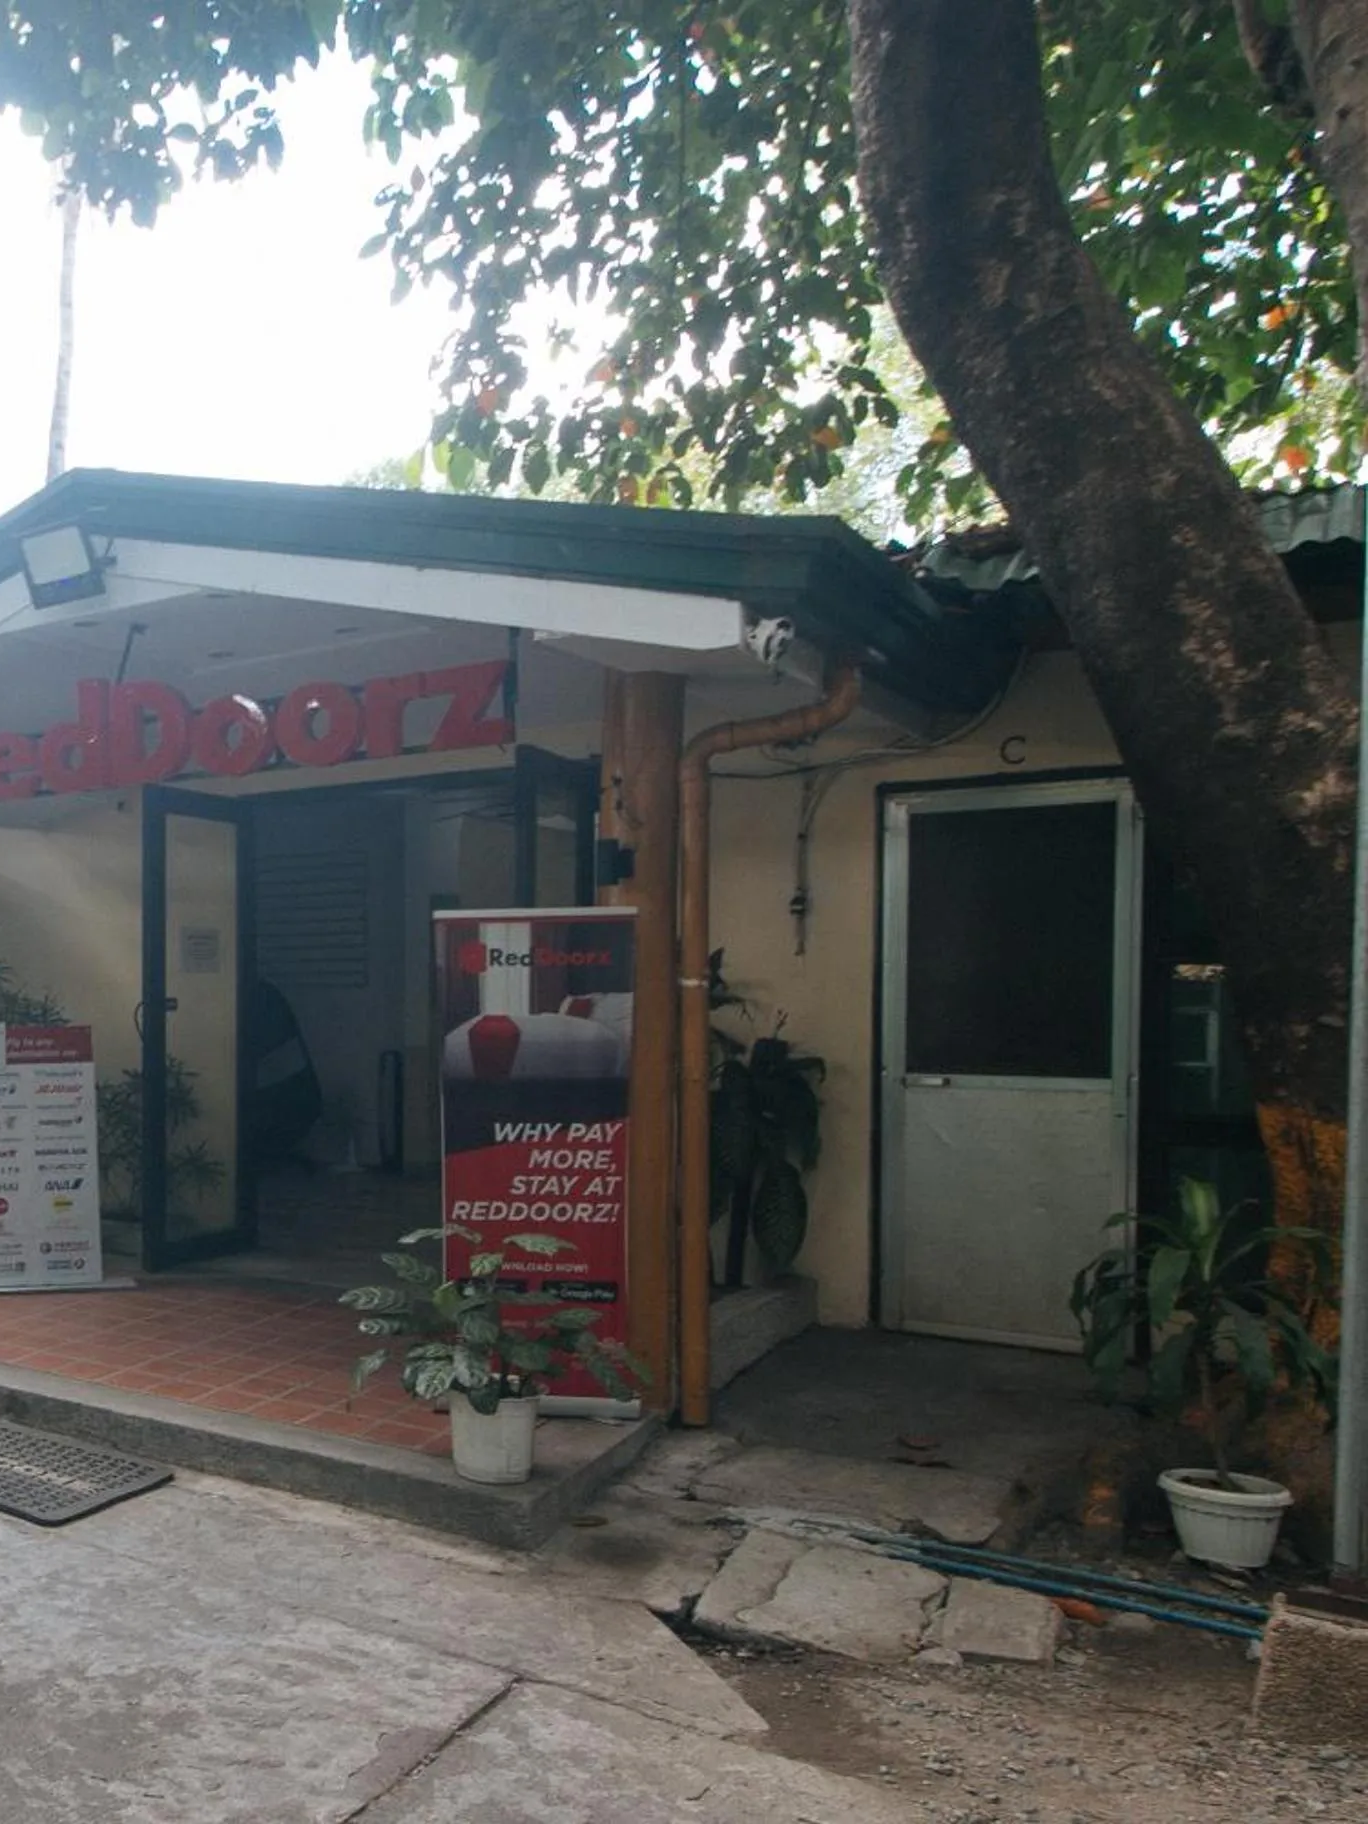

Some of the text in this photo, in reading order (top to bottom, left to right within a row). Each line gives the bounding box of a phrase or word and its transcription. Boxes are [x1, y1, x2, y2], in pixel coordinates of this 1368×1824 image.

[1000, 735, 1026, 764] C
[493, 1122, 623, 1143] WHY PAY
[528, 1149, 617, 1173] MORE,
[510, 1175, 623, 1196] STAY AT
[451, 1201, 620, 1223] REDDOORZ!
[499, 1261, 553, 1273] WNLOAD
